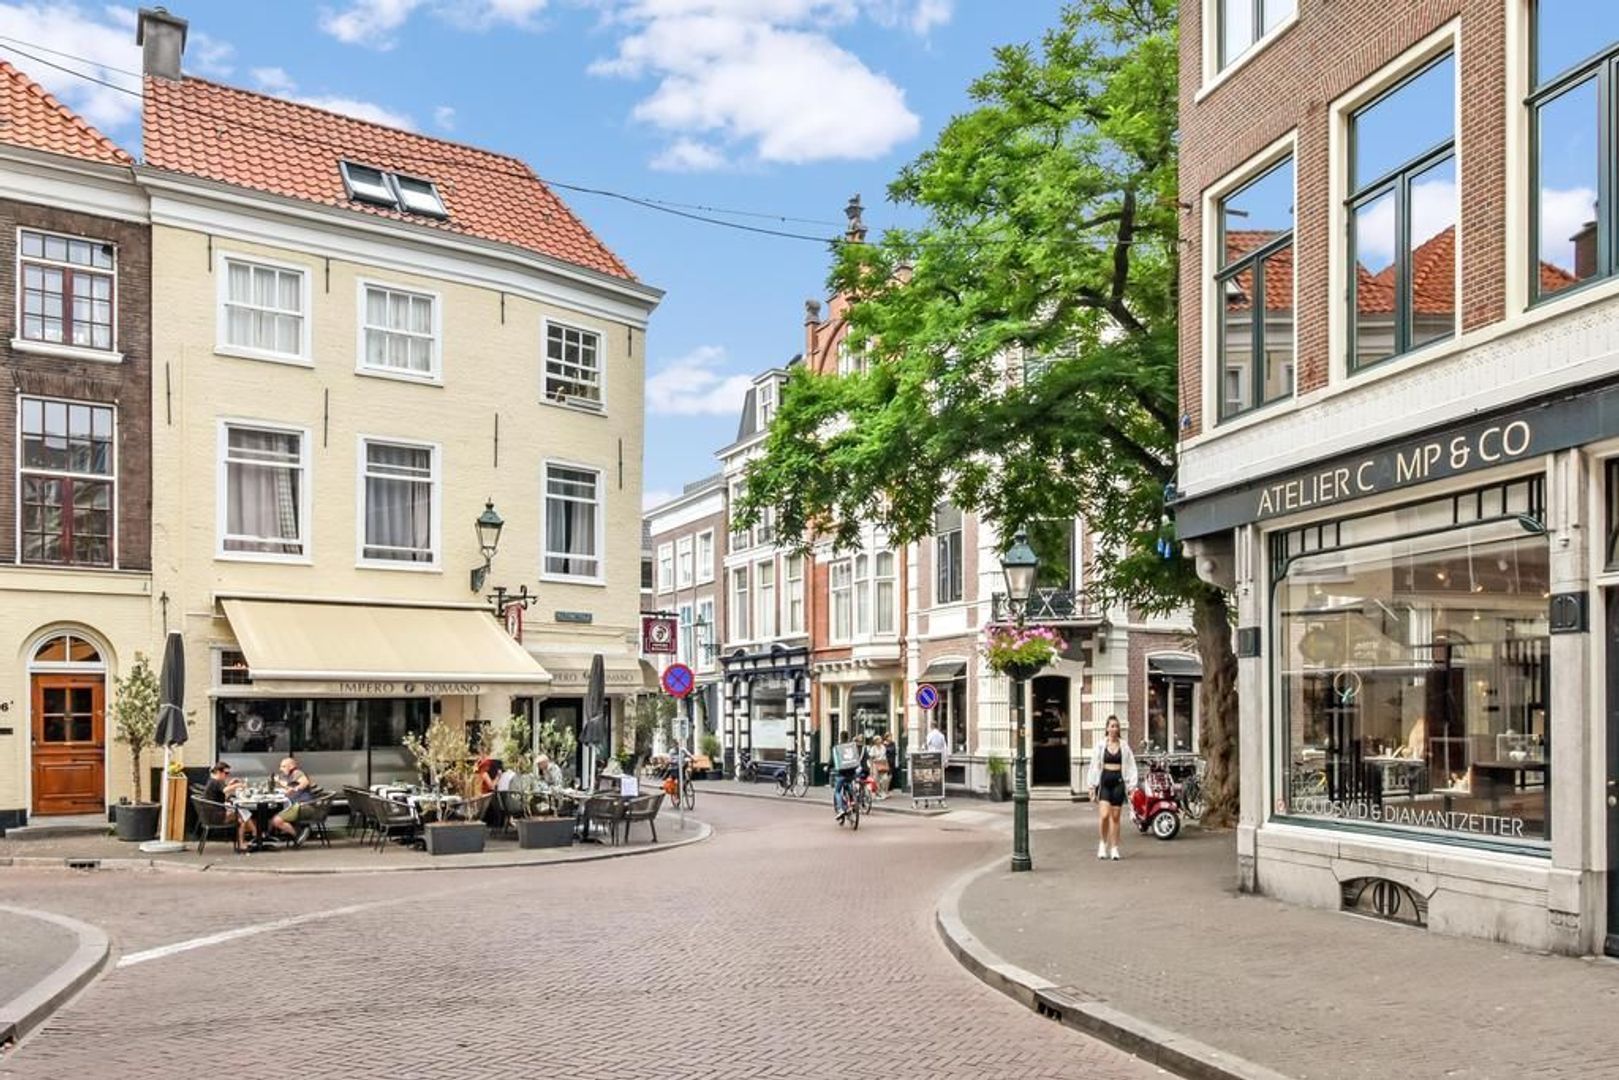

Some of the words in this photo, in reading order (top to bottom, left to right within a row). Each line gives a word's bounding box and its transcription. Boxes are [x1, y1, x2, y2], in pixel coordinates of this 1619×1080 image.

[1256, 467, 1351, 518] ATELIER
[1449, 435, 1471, 470] &
[1478, 420, 1531, 462] CO
[339, 682, 395, 694] IMPERO
[423, 683, 481, 694] ROMANO
[1369, 803, 1382, 821] &
[1384, 804, 1525, 838] DIAMANTZETTER
